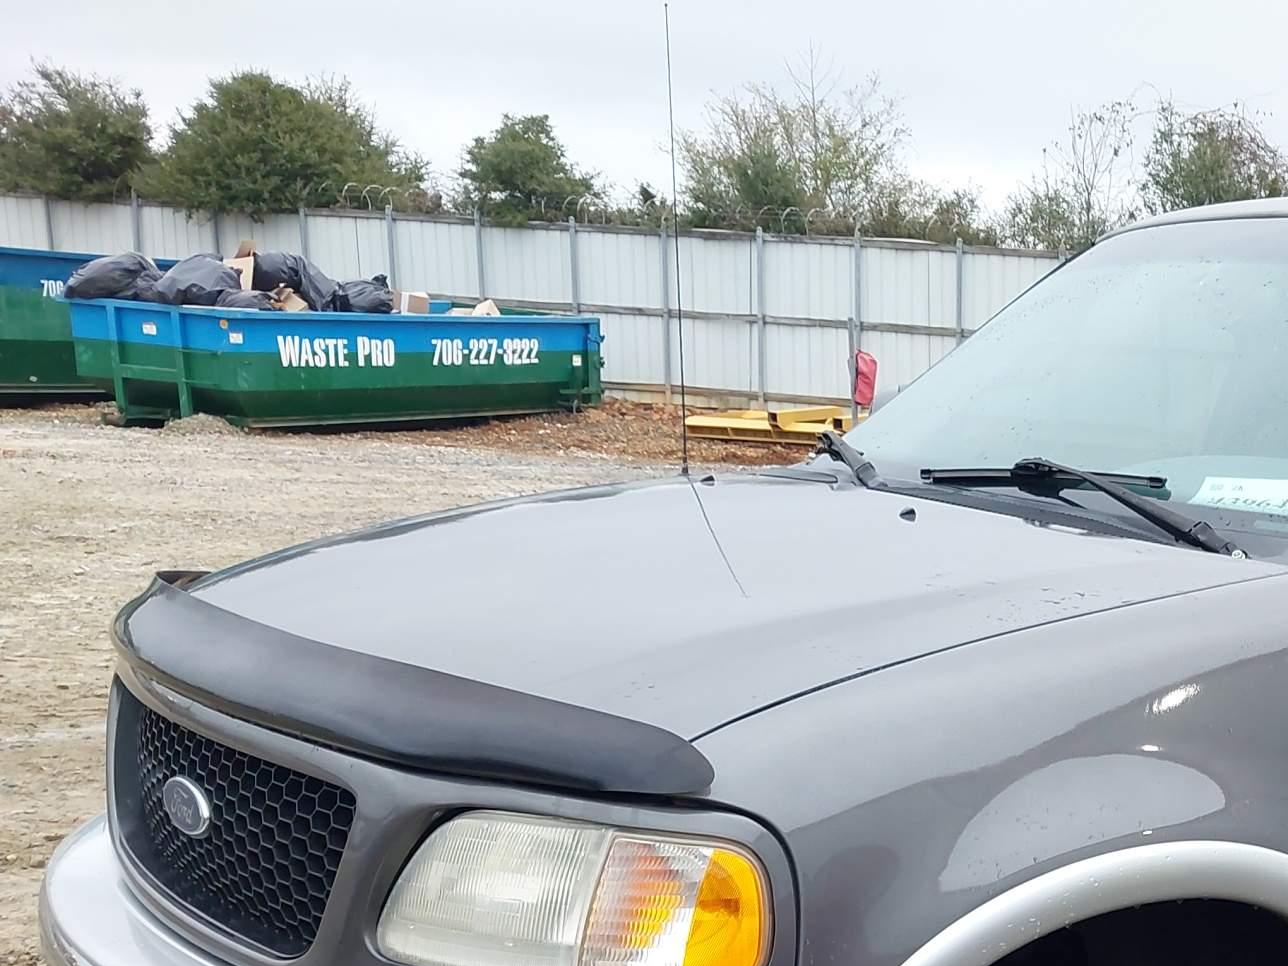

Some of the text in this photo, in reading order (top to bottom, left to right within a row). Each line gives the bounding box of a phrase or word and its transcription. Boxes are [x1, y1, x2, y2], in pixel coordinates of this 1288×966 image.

[277, 335, 540, 368] WASTE PRO 706-227-3222
